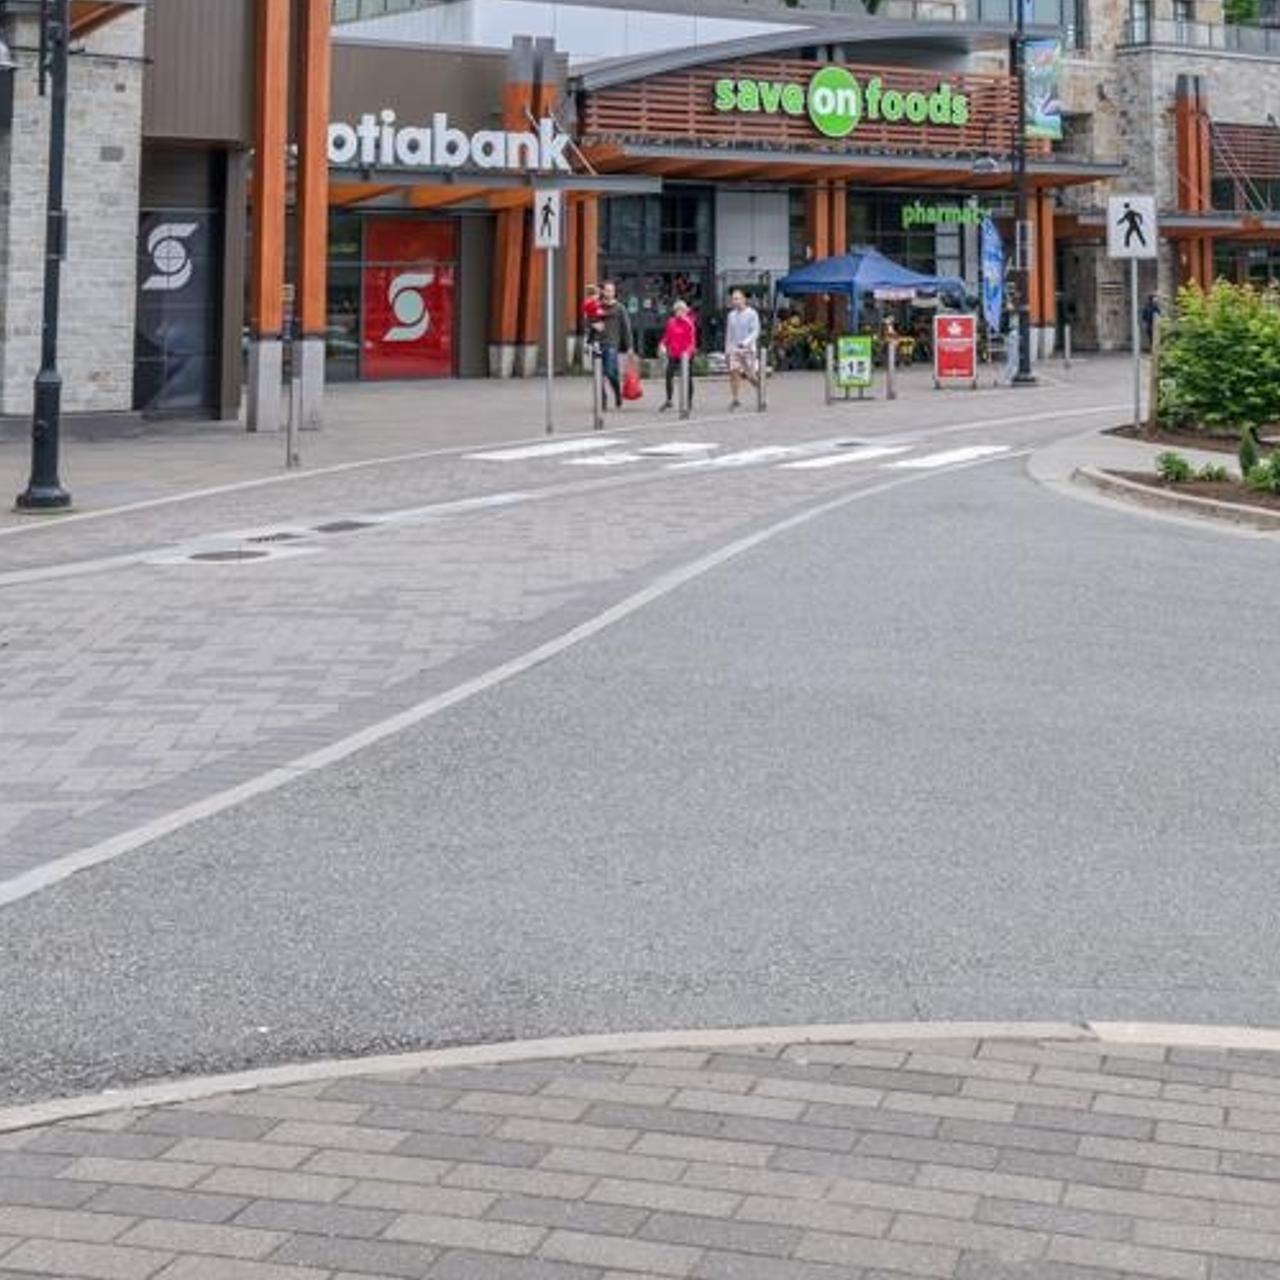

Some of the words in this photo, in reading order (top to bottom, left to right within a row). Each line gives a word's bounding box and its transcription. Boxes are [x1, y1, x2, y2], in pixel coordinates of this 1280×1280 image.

[715, 78, 806, 115] save
[812, 86, 857, 117] on
[866, 76, 969, 125] foods
[250, 109, 572, 172] otiabank
